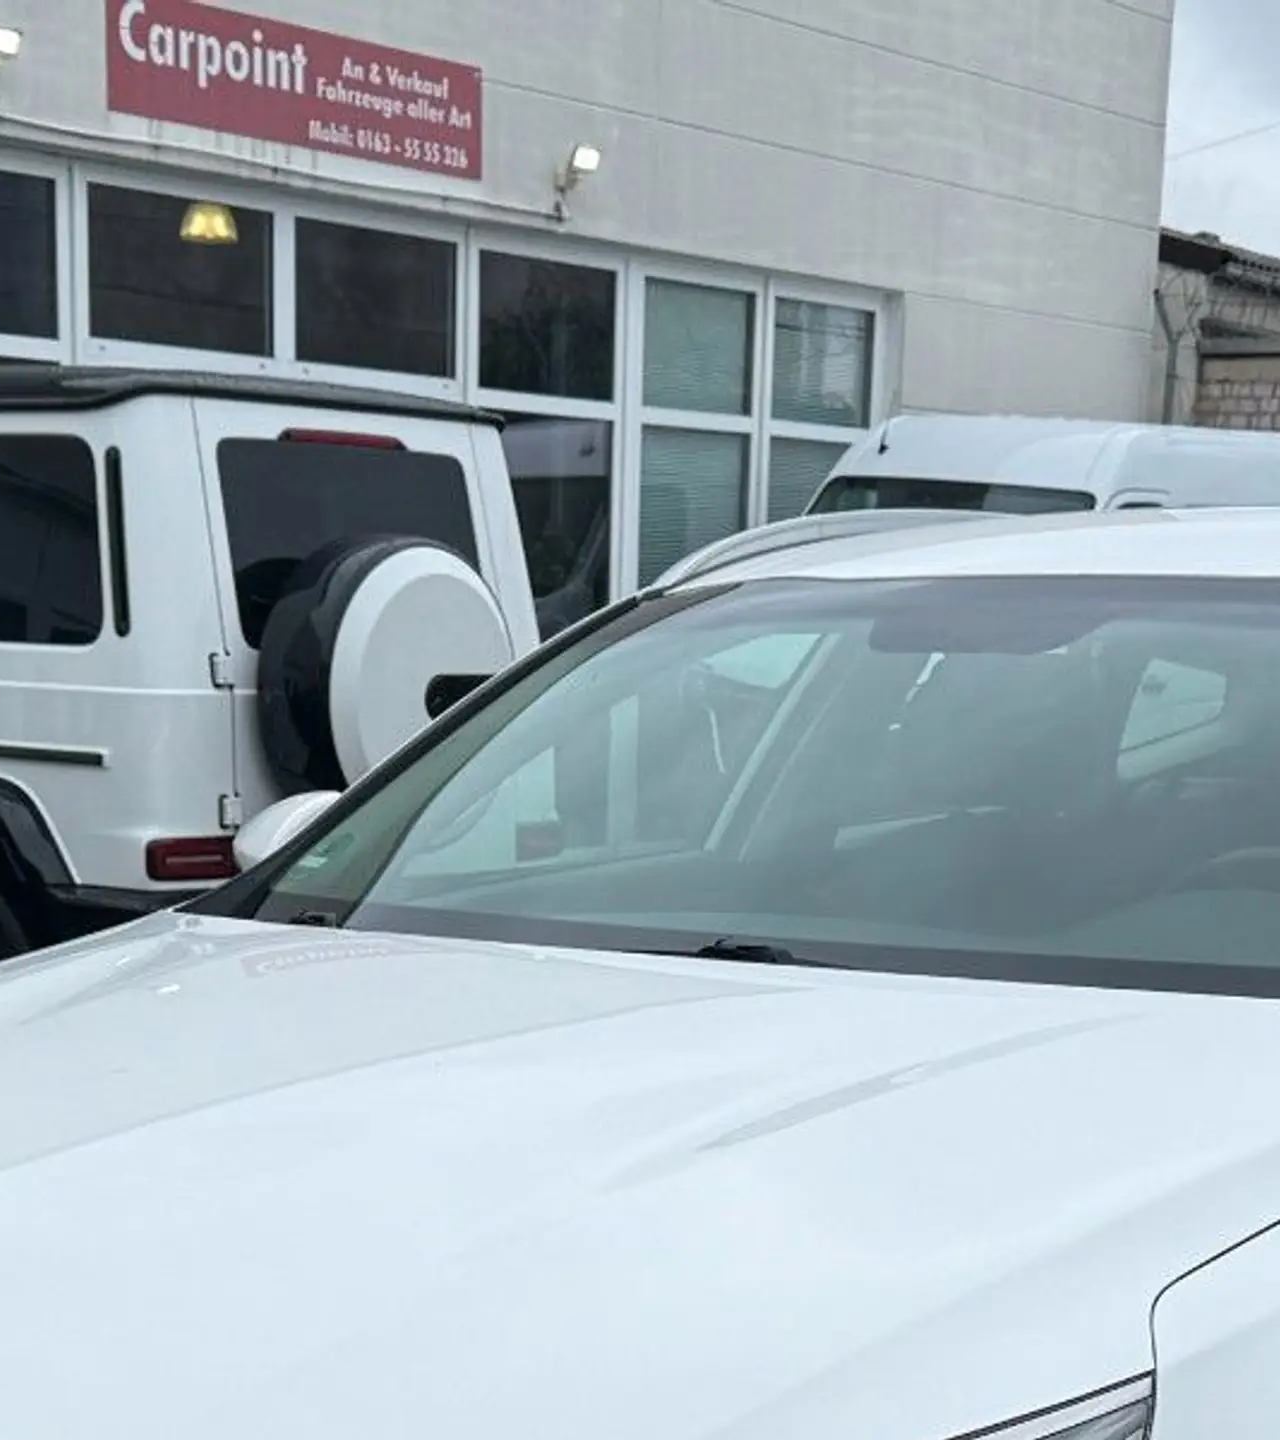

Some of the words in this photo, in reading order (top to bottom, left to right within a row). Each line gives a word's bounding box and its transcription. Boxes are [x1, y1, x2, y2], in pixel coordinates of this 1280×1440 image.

[119, 0, 308, 94] Carpoint
[316, 77, 403, 119] Fahrzeuge
[407, 98, 446, 124] aller
[448, 105, 472, 129] Art
[342, 56, 364, 82] An
[369, 62, 382, 85] &
[386, 65, 449, 100] Verkauf
